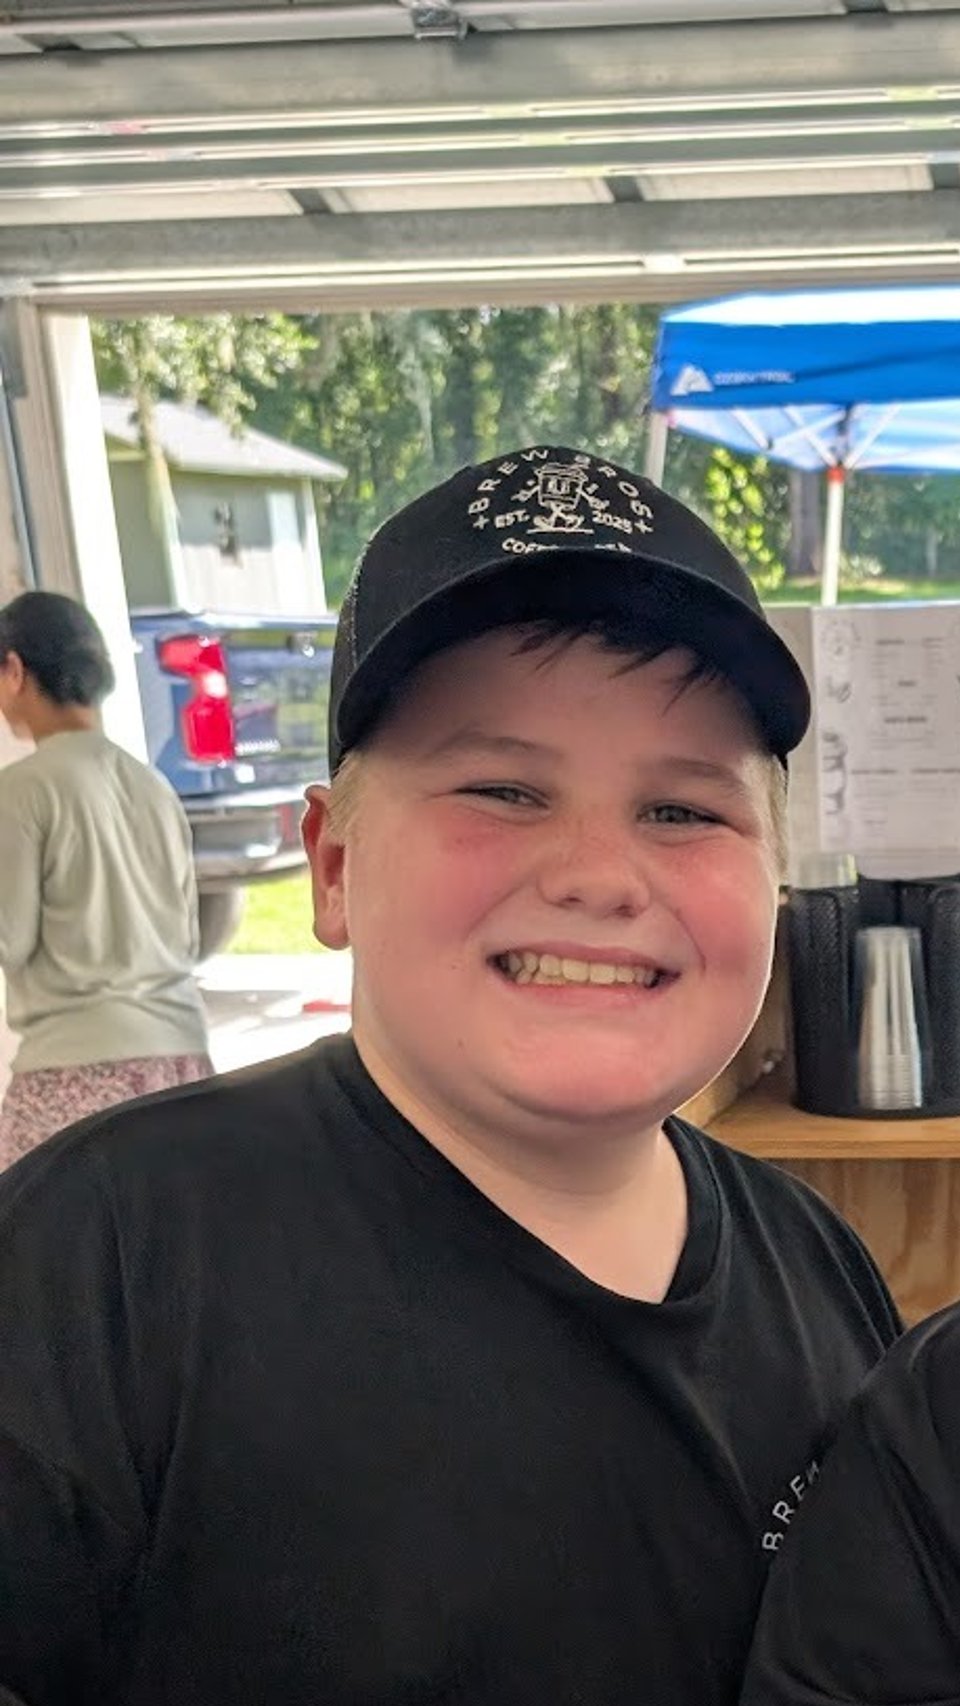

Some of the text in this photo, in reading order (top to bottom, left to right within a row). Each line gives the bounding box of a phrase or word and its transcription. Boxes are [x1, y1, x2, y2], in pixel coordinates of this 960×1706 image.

[468, 449, 654, 519] BREW BROS
[494, 509, 530, 529] EST.
